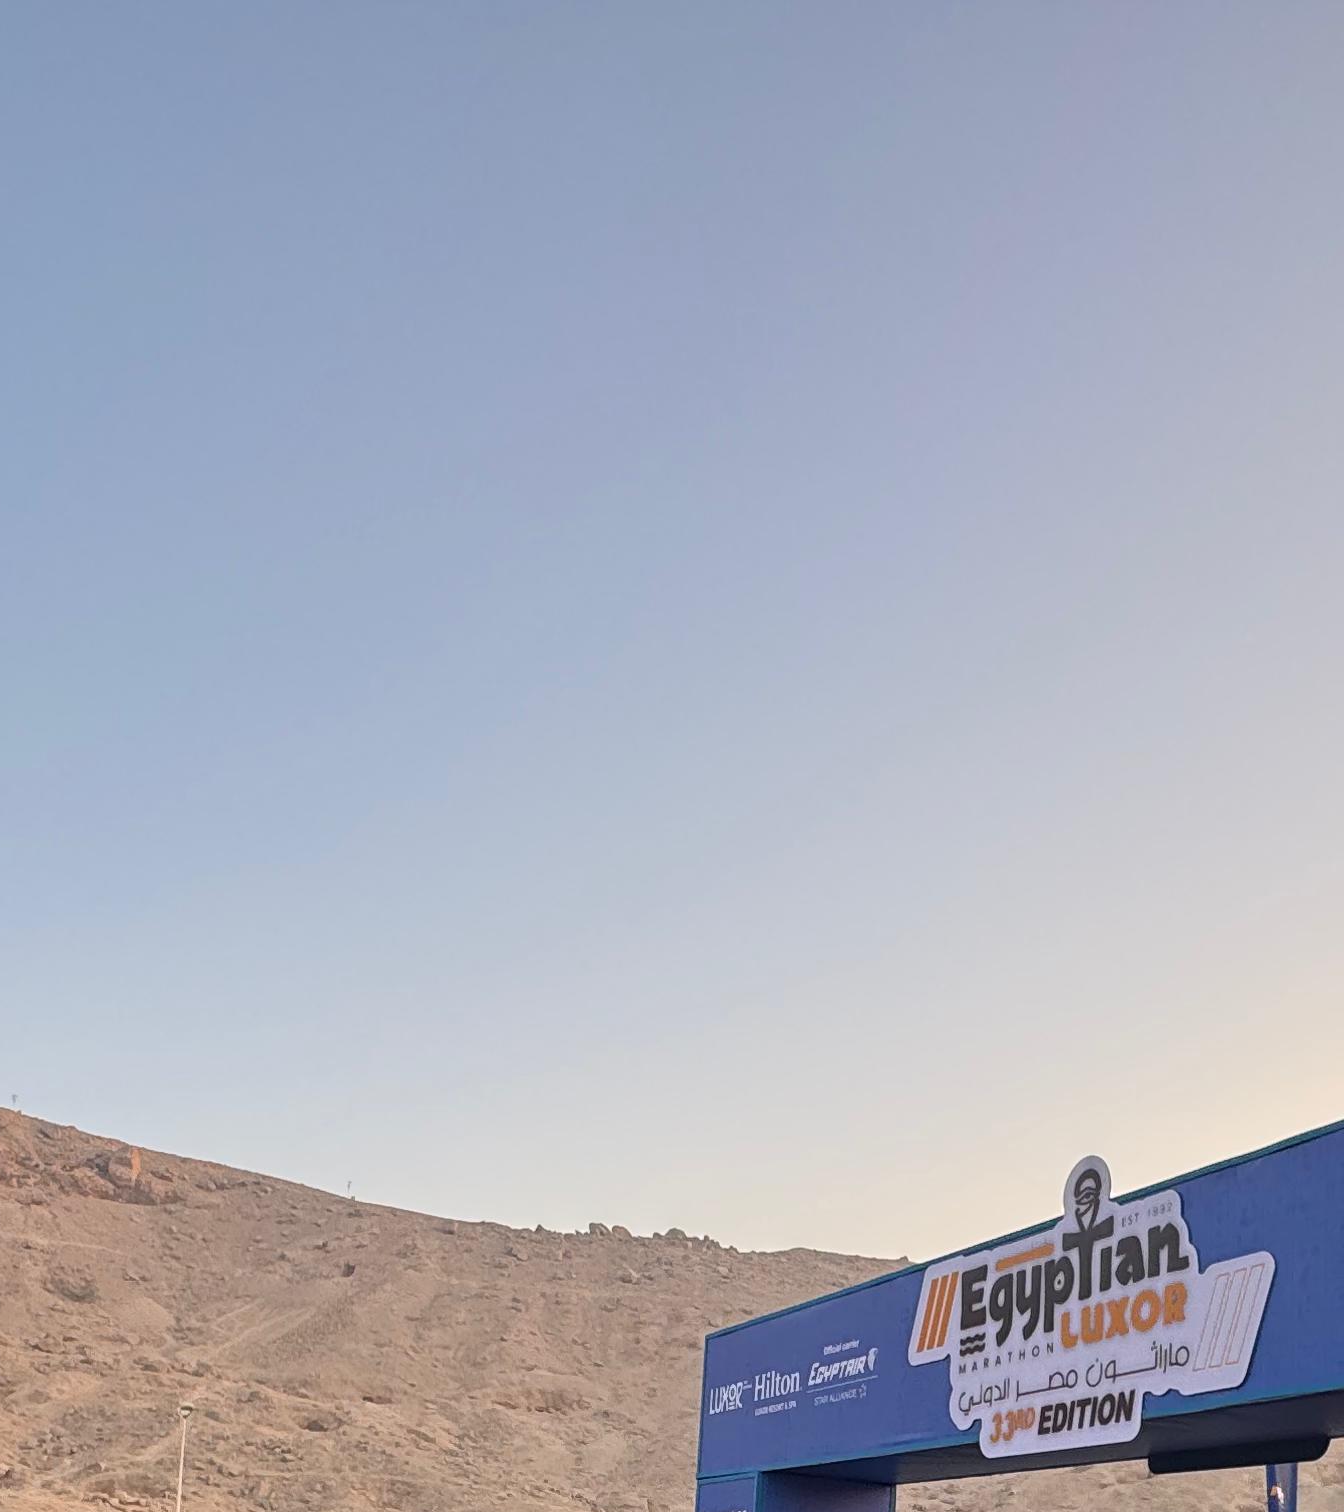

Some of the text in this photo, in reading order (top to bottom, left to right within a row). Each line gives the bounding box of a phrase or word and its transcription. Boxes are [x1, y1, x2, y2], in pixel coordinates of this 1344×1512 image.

[1122, 1211, 1141, 1228] EST
[1061, 1282, 1188, 1349] LUXOR
[808, 1355, 867, 1386] EGYPTAIR
[959, 1343, 1054, 1374] MARATHON
[709, 1382, 744, 1415] LUXOR
[754, 1370, 801, 1401] Hilton
[1017, 1369, 1078, 1402] مصر
[990, 1389, 1136, 1443] 33RD EDITION
